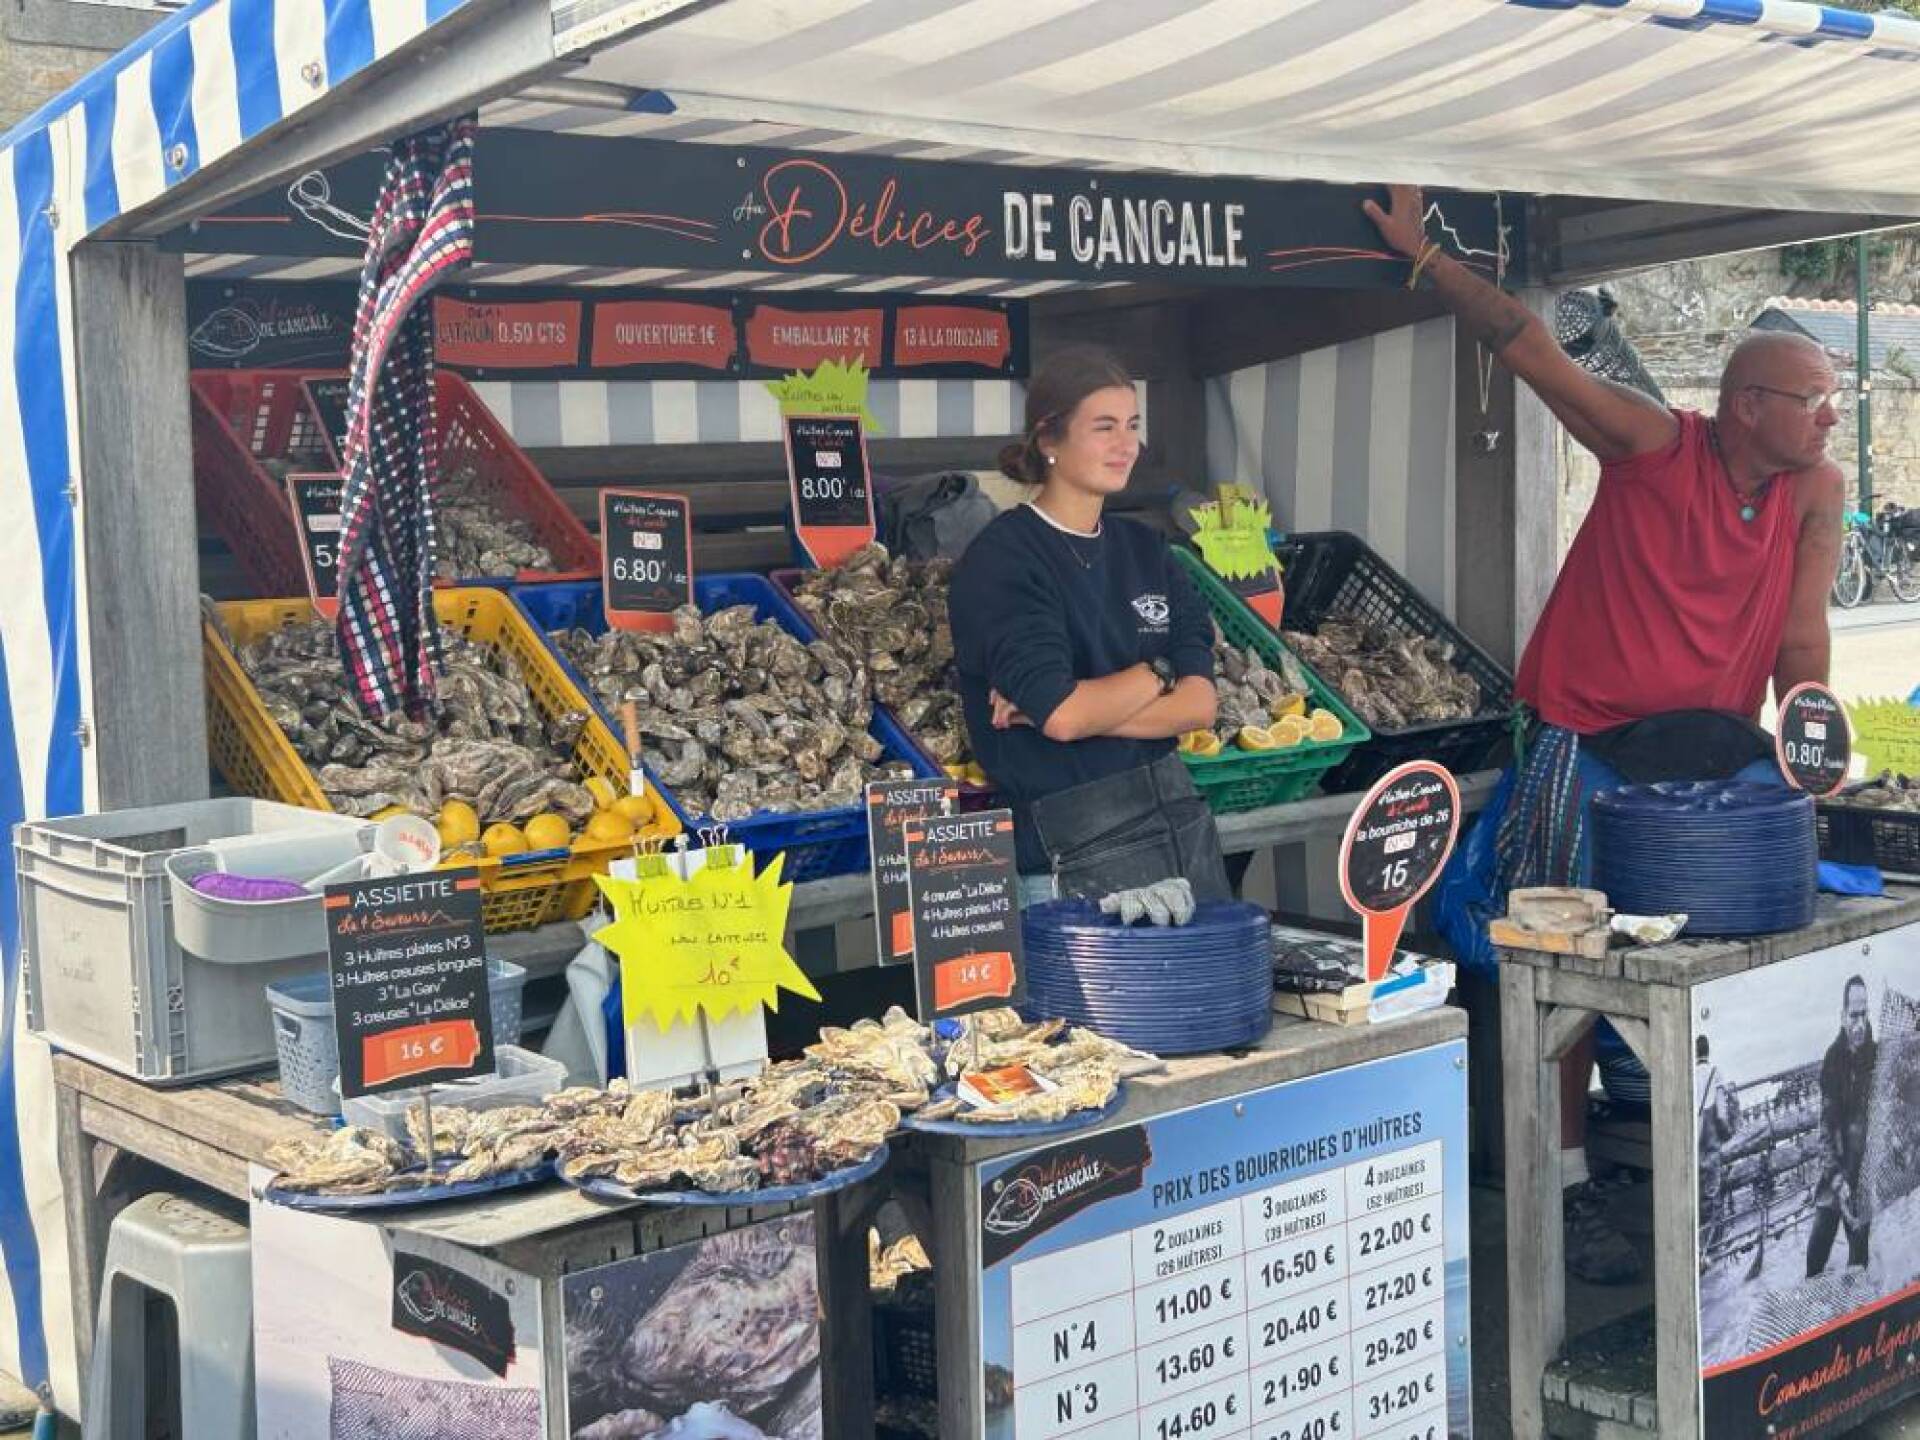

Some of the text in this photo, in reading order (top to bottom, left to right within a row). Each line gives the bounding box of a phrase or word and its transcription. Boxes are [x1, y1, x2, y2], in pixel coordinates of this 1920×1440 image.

[759, 159, 991, 264] Délices
[1003, 191, 1057, 262] DE
[1069, 195, 1248, 268] CANCALE
[498, 321, 533, 344] 0.50
[537, 321, 566, 345] CTS
[615, 323, 696, 345] OUVERTURE
[773, 325, 849, 346] EMBALLAGE
[887, 787, 944, 806] ASSIETTE
[927, 822, 994, 843] ASSIETTE
[1368, 818, 1418, 841] bourriche
[355, 880, 454, 909] ASSIETTE
[345, 934, 472, 967] 3 Huîtres plates N°3
[336, 955, 483, 988] 3 Huîtres creuses longues
[961, 963, 991, 984] 14 €
[377, 986, 388, 1001] 3
[353, 1011, 362, 1026] 3
[363, 1008, 410, 1025] creuses
[401, 1036, 445, 1061] 16 €
[1153, 1111, 1423, 1209] PRIX DES BOURRICHES D'HUÎTRES
[1364, 1159, 1426, 1188] 4 DOUZAINES
[1042, 1160, 1101, 1203] DE CANCALE
[1262, 1187, 1328, 1220] 3 DOUZAINES
[1154, 1220, 1223, 1253] 2 DOUZAINES
[1360, 1212, 1432, 1257] 22.00 €
[1261, 1243, 1336, 1289] 16.50 €
[1155, 1278, 1232, 1324] 11.00 €
[1365, 1266, 1433, 1311] 27.20 €
[1263, 1299, 1337, 1347] 20.40 €
[1054, 1320, 1097, 1364] N°4
[1365, 1320, 1433, 1368] 29.20 €
[1156, 1335, 1234, 1384] 13.60 €
[1264, 1355, 1340, 1406] 21.90 €
[1369, 1372, 1435, 1420] 31.20 €
[1758, 1344, 1853, 1417] Commandes
[1856, 1346, 1873, 1369] en
[1057, 1381, 1099, 1424] N°3
[1157, 1393, 1238, 1440] 14.60 €
[1330, 1410, 1341, 1432] €
